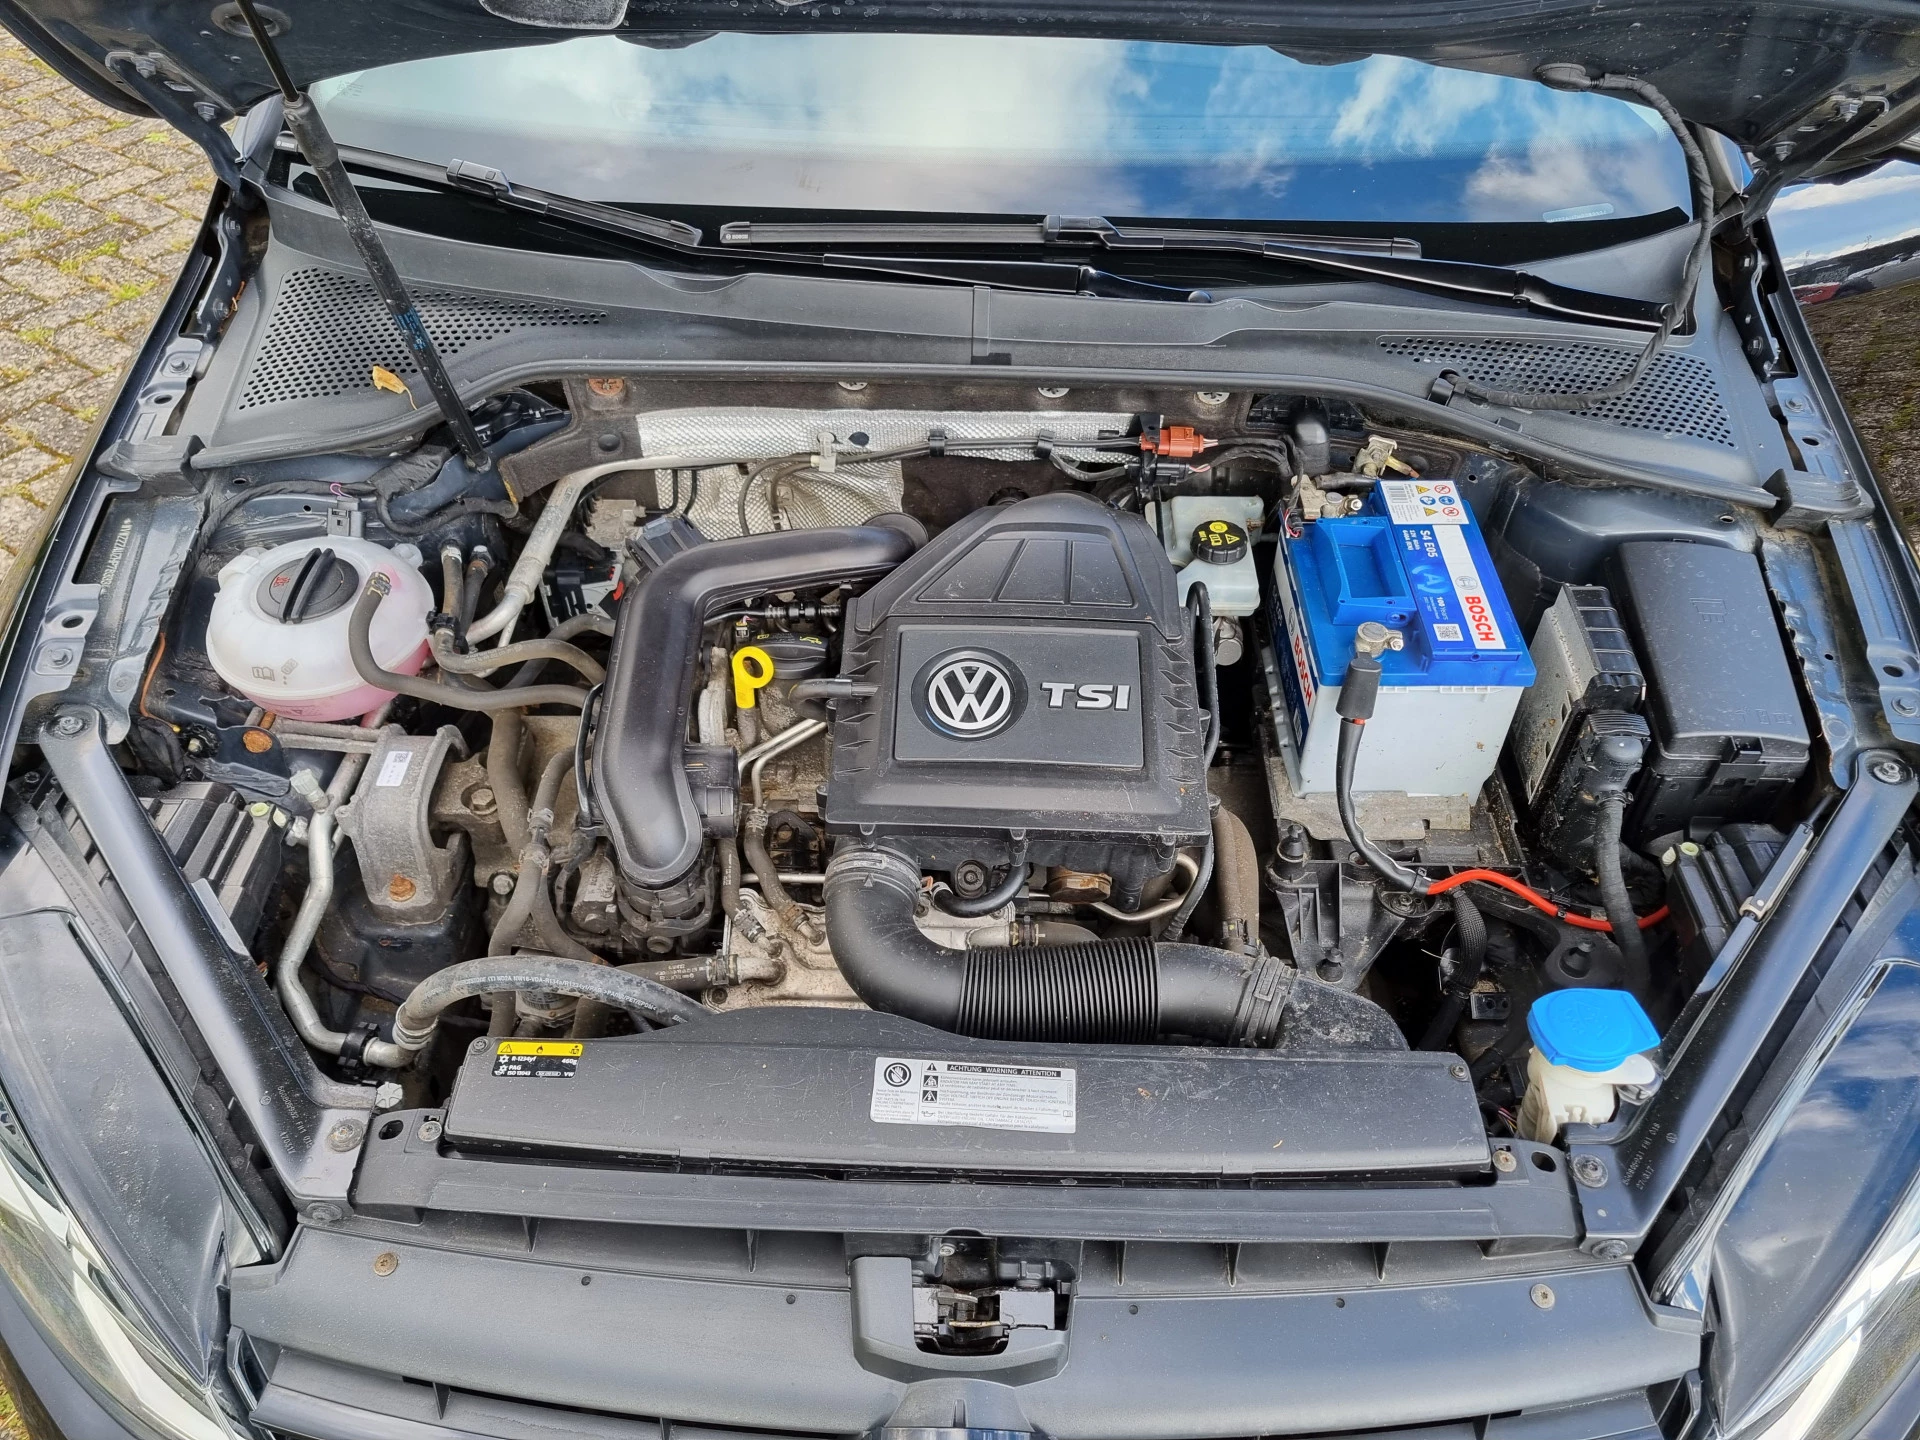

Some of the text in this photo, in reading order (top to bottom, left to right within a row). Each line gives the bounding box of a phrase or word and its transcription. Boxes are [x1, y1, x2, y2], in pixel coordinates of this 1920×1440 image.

[1420, 530, 1438, 558] S4 E05
[1465, 596, 1496, 642] BOSCH
[1294, 633, 1313, 707] BOSCH
[928, 661, 1011, 730] VW
[1040, 681, 1131, 711] TSI
[949, 1065, 1057, 1077] ACHTUNG WARNING ATTENTION
